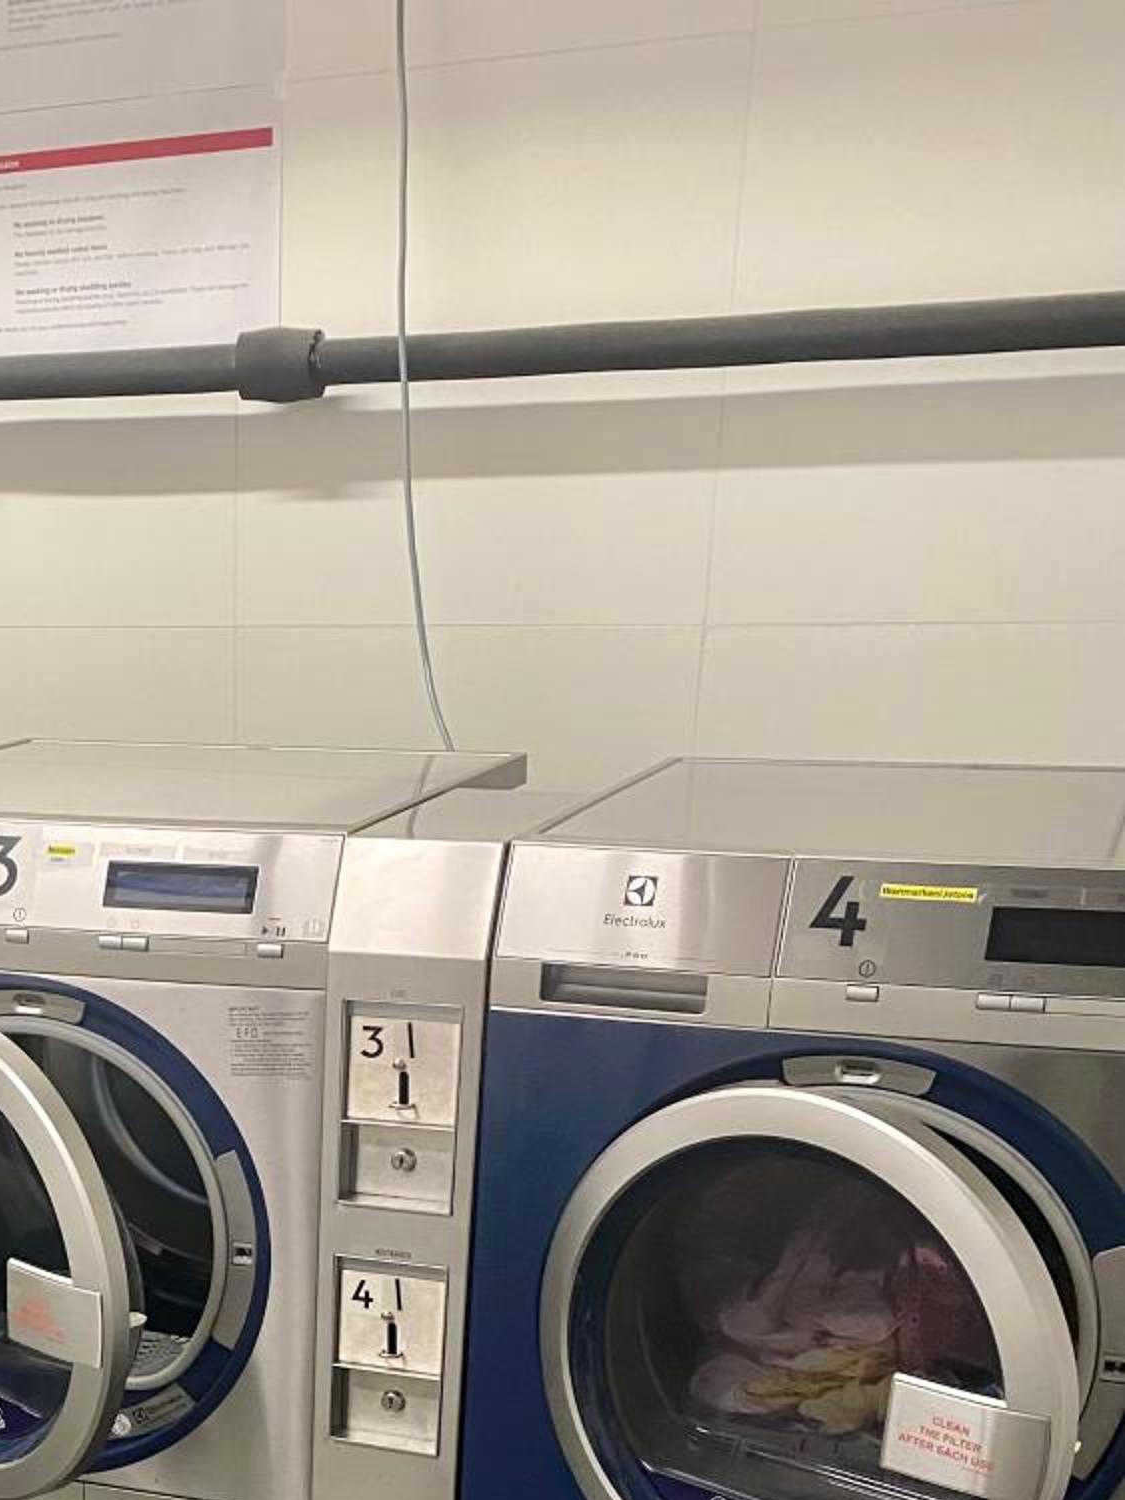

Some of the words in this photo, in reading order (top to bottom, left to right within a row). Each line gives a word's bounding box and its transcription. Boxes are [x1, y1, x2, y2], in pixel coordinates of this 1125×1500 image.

[603, 912, 667, 929] Electrolux
[809, 875, 867, 949] 4
[360, 1025, 384, 1059] 3
[351, 1279, 374, 1309] 4
[919, 1425, 941, 1442] THE
[942, 1433, 983, 1454] FILTER
[931, 1415, 971, 1437] CLEAN
[898, 1432, 934, 1453] AFTER
[936, 1444, 969, 1466] EACH
[970, 1457, 995, 1474] USE
